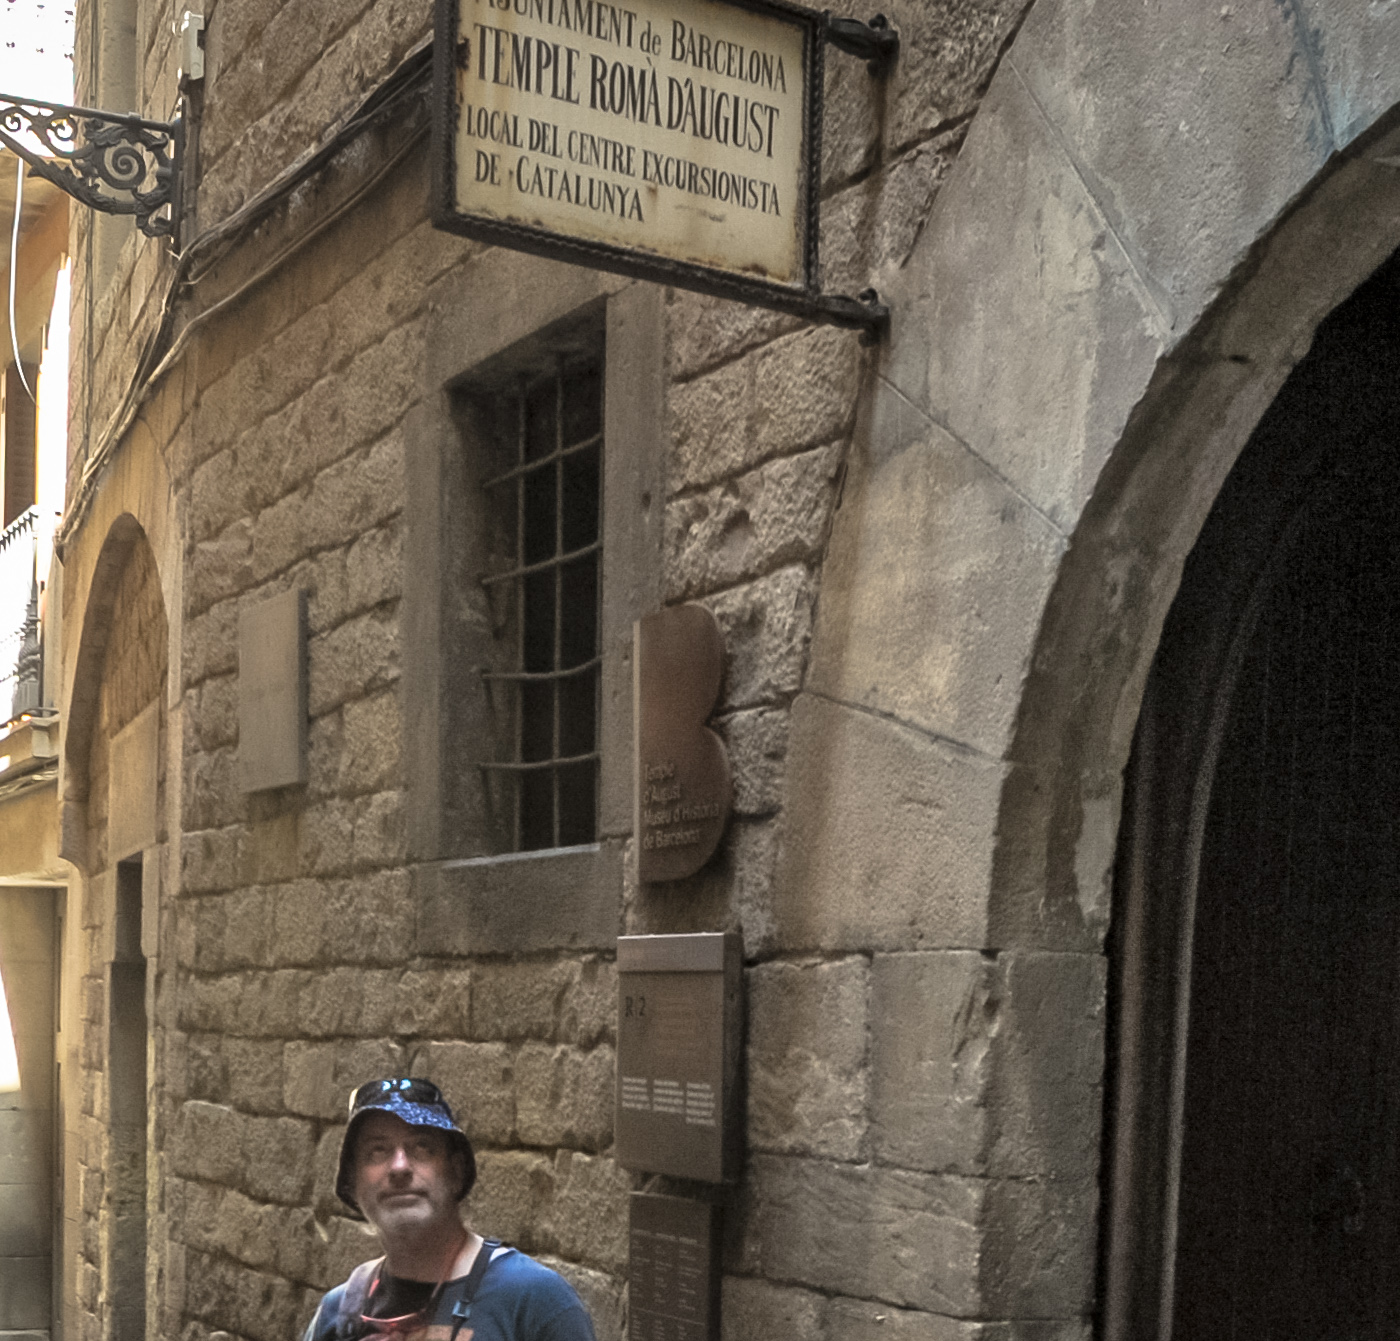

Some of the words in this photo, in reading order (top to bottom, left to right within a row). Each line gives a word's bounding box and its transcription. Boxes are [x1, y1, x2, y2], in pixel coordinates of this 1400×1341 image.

[474, 23, 580, 105] TEMPLE
[590, 53, 662, 127] ROMÀ
[475, 0, 637, 48] NTAMENT
[640, 21, 662, 55] de
[671, 19, 787, 94] BARCELONA
[466, 104, 524, 149] LOCAL
[528, 118, 563, 158] DEL
[568, 130, 636, 178] CENTRE
[642, 149, 782, 217] EXCURSIONISTA
[475, 149, 501, 187] DE
[516, 155, 645, 223] CATALUNYA
